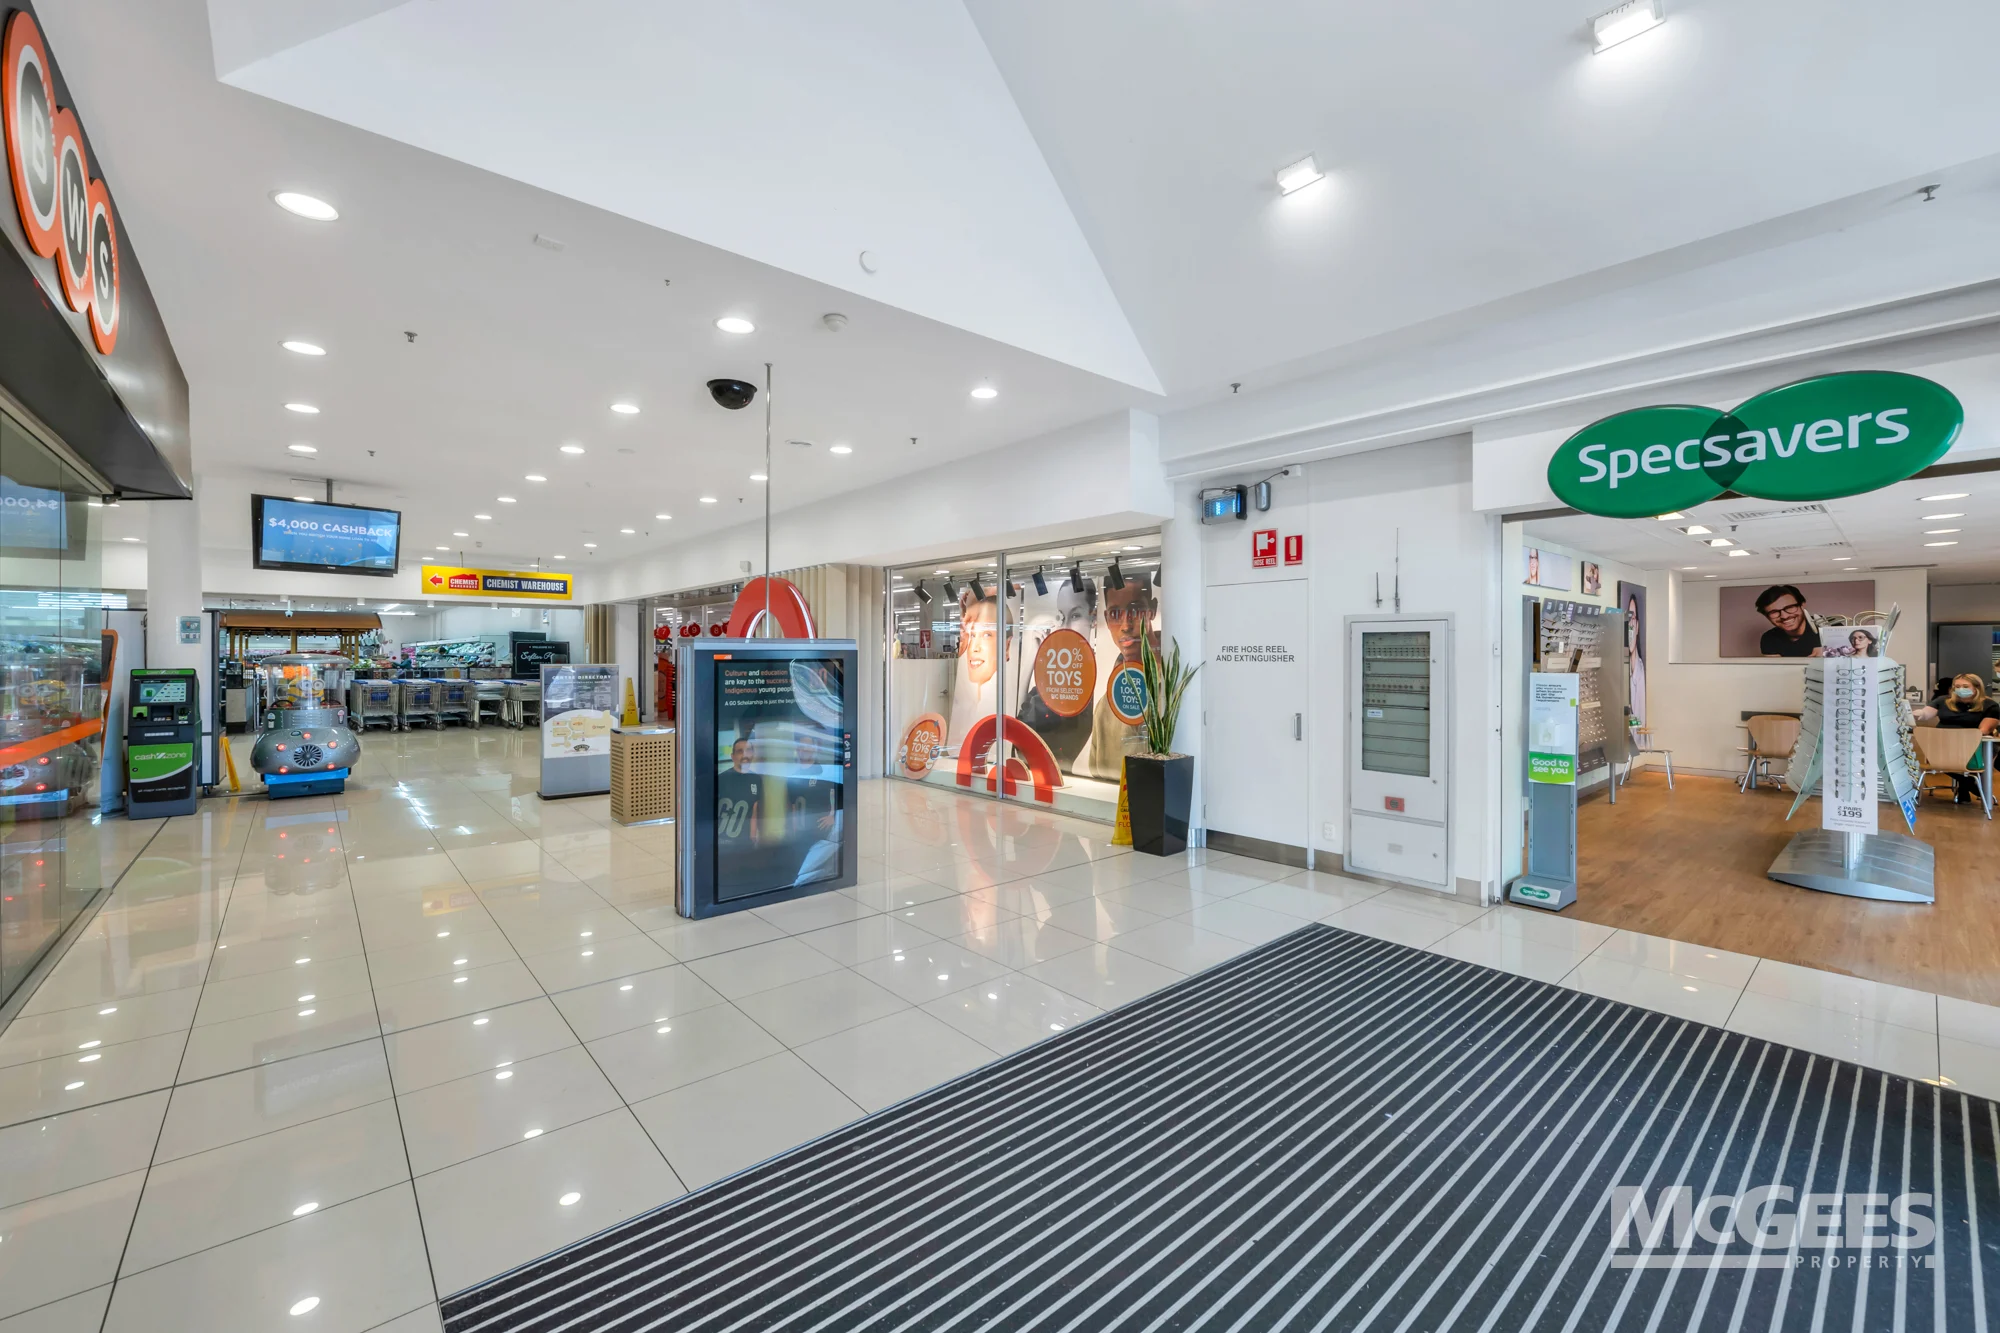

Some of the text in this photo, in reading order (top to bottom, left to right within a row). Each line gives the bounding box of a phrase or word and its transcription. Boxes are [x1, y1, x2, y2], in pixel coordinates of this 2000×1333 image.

[1578, 407, 1911, 490] Specsavers
[268, 517, 392, 538] $4,000 CASHBACK
[450, 578, 478, 586] CHEMIST
[486, 578, 564, 592] CHEMIST WAREHOUSE
[1221, 645, 1288, 653] FIRE HOSE REEL
[1215, 654, 1295, 662] AND EXTINGUISHER
[1046, 670, 1082, 687] TOYS
[1121, 677, 1141, 686] OER
[724, 687, 758, 695] Indigenous
[1059, 687, 1084, 695] SELECTED
[911, 742, 930, 754] TOYS
[1531, 757, 1570, 767] Good to
[1550, 767, 1569, 775] you
[1837, 810, 1863, 819] $199
